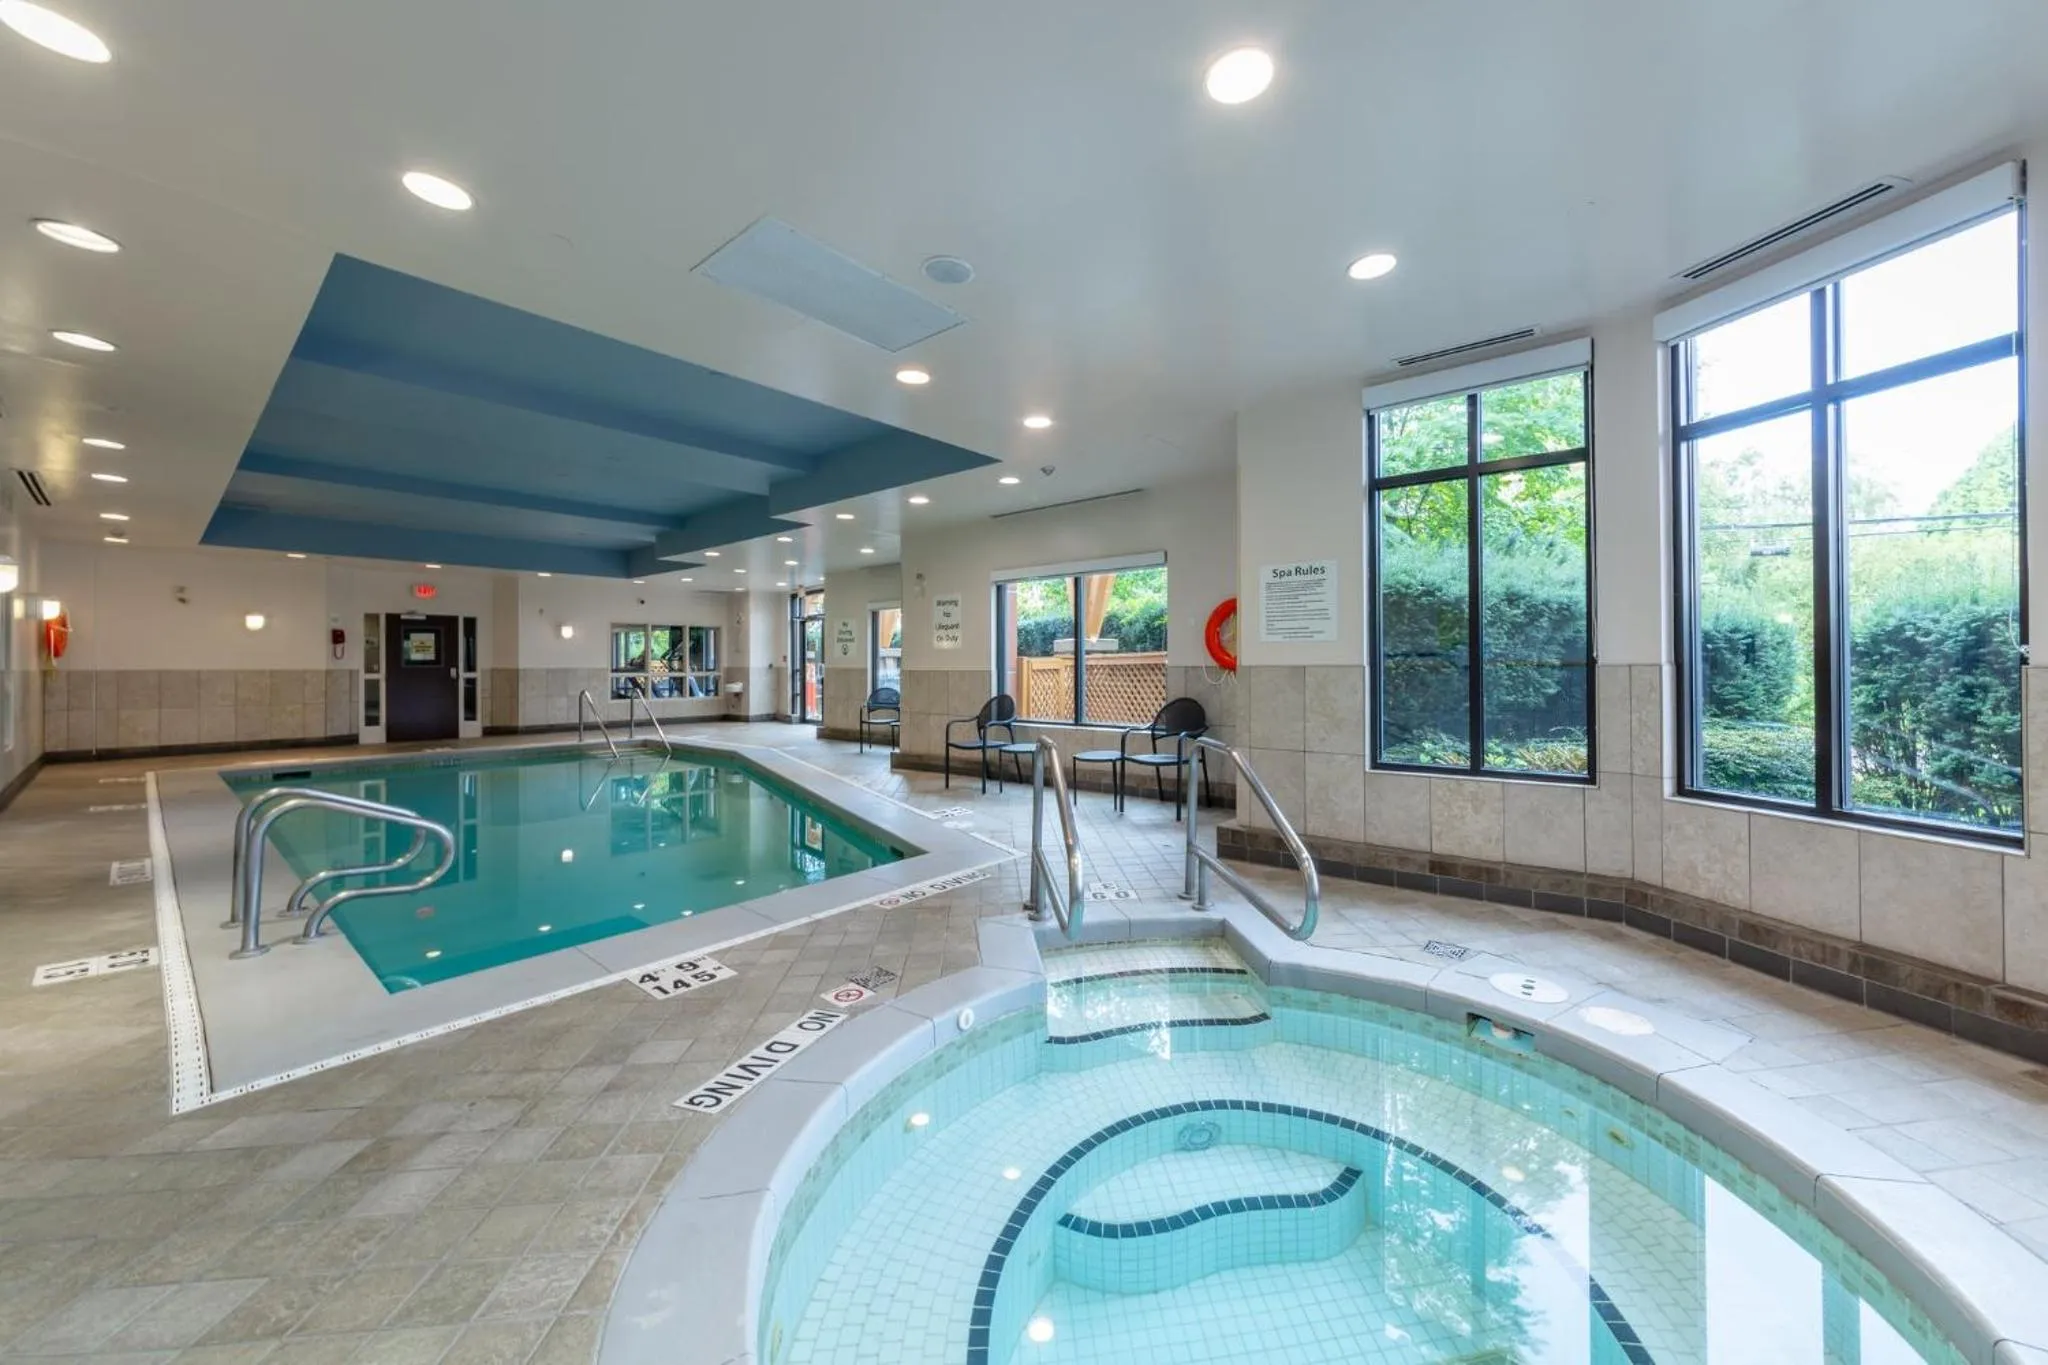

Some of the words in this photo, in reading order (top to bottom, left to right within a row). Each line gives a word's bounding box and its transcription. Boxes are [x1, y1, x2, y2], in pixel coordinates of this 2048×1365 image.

[1272, 568, 1292, 579] Spa
[1295, 565, 1326, 576] Rules
[798, 1011, 841, 1031] NO
[684, 1040, 800, 1108] DIVING
